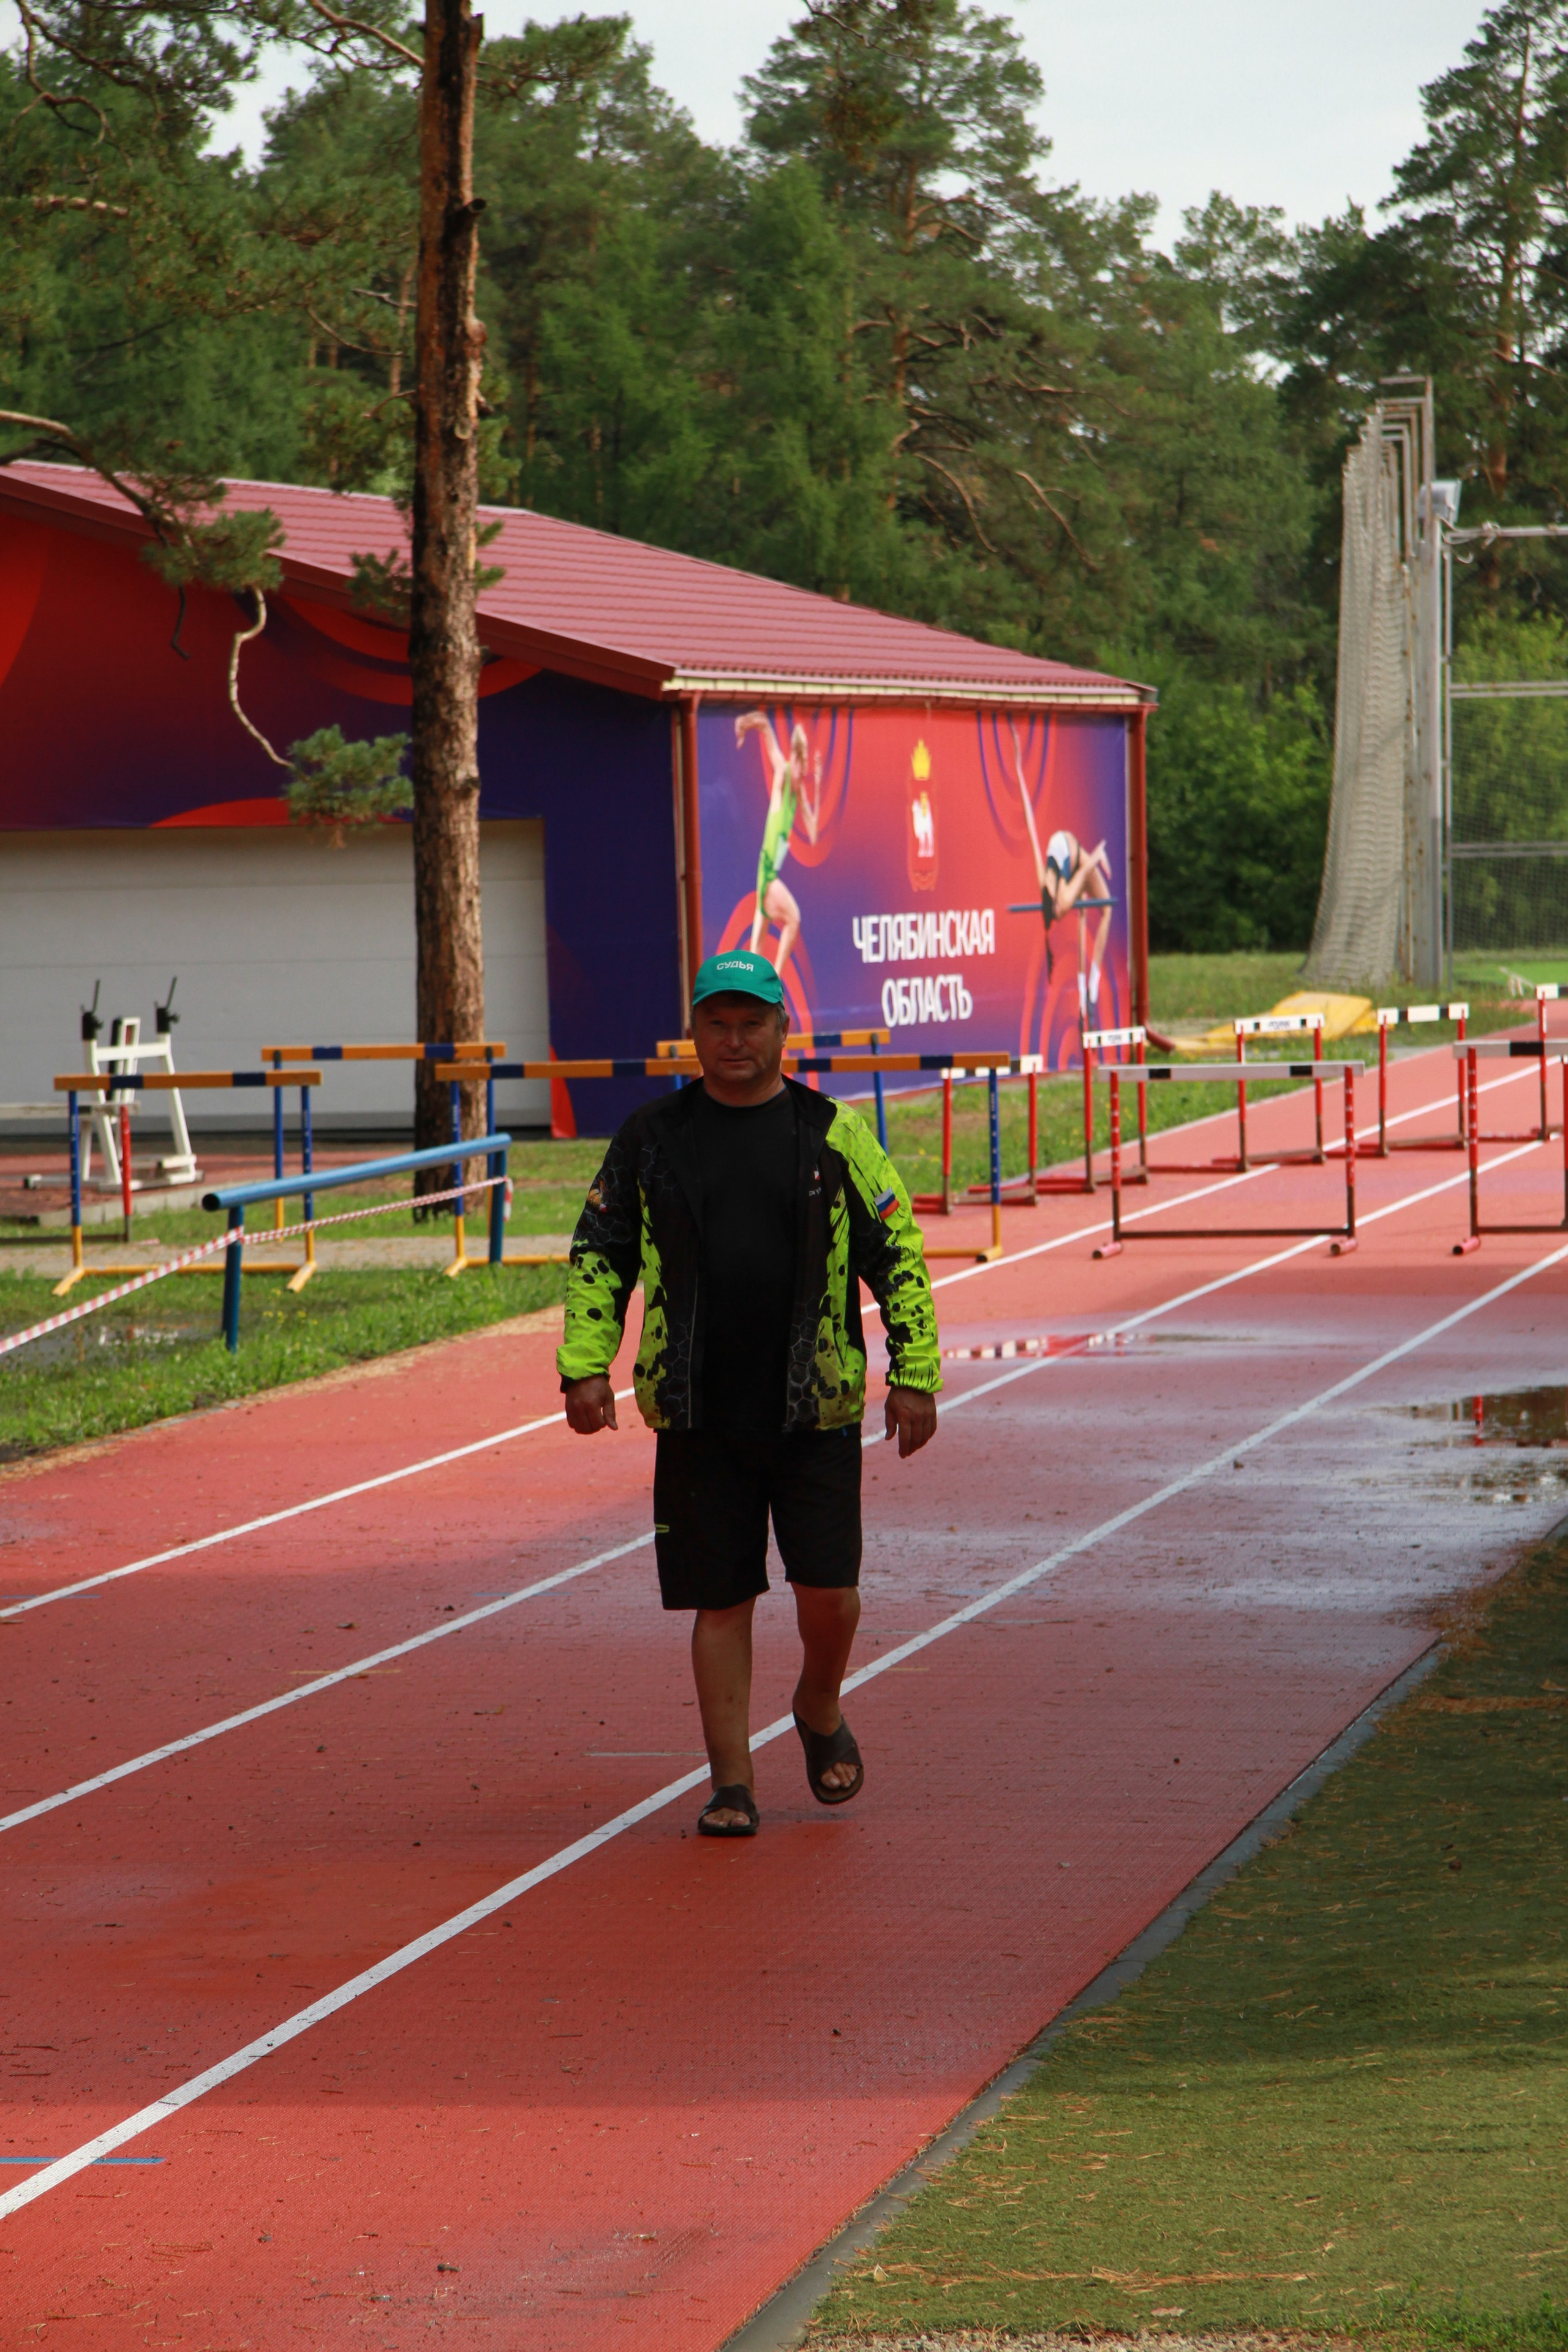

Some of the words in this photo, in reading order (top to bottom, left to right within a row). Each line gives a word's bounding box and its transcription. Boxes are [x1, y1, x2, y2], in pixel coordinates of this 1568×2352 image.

[852, 908, 995, 963] ЧЕЛЯБИНСКАЯ
[717, 960, 754, 972] СУДЬЯ
[881, 974, 973, 1028] ОБЛАСТЬ
